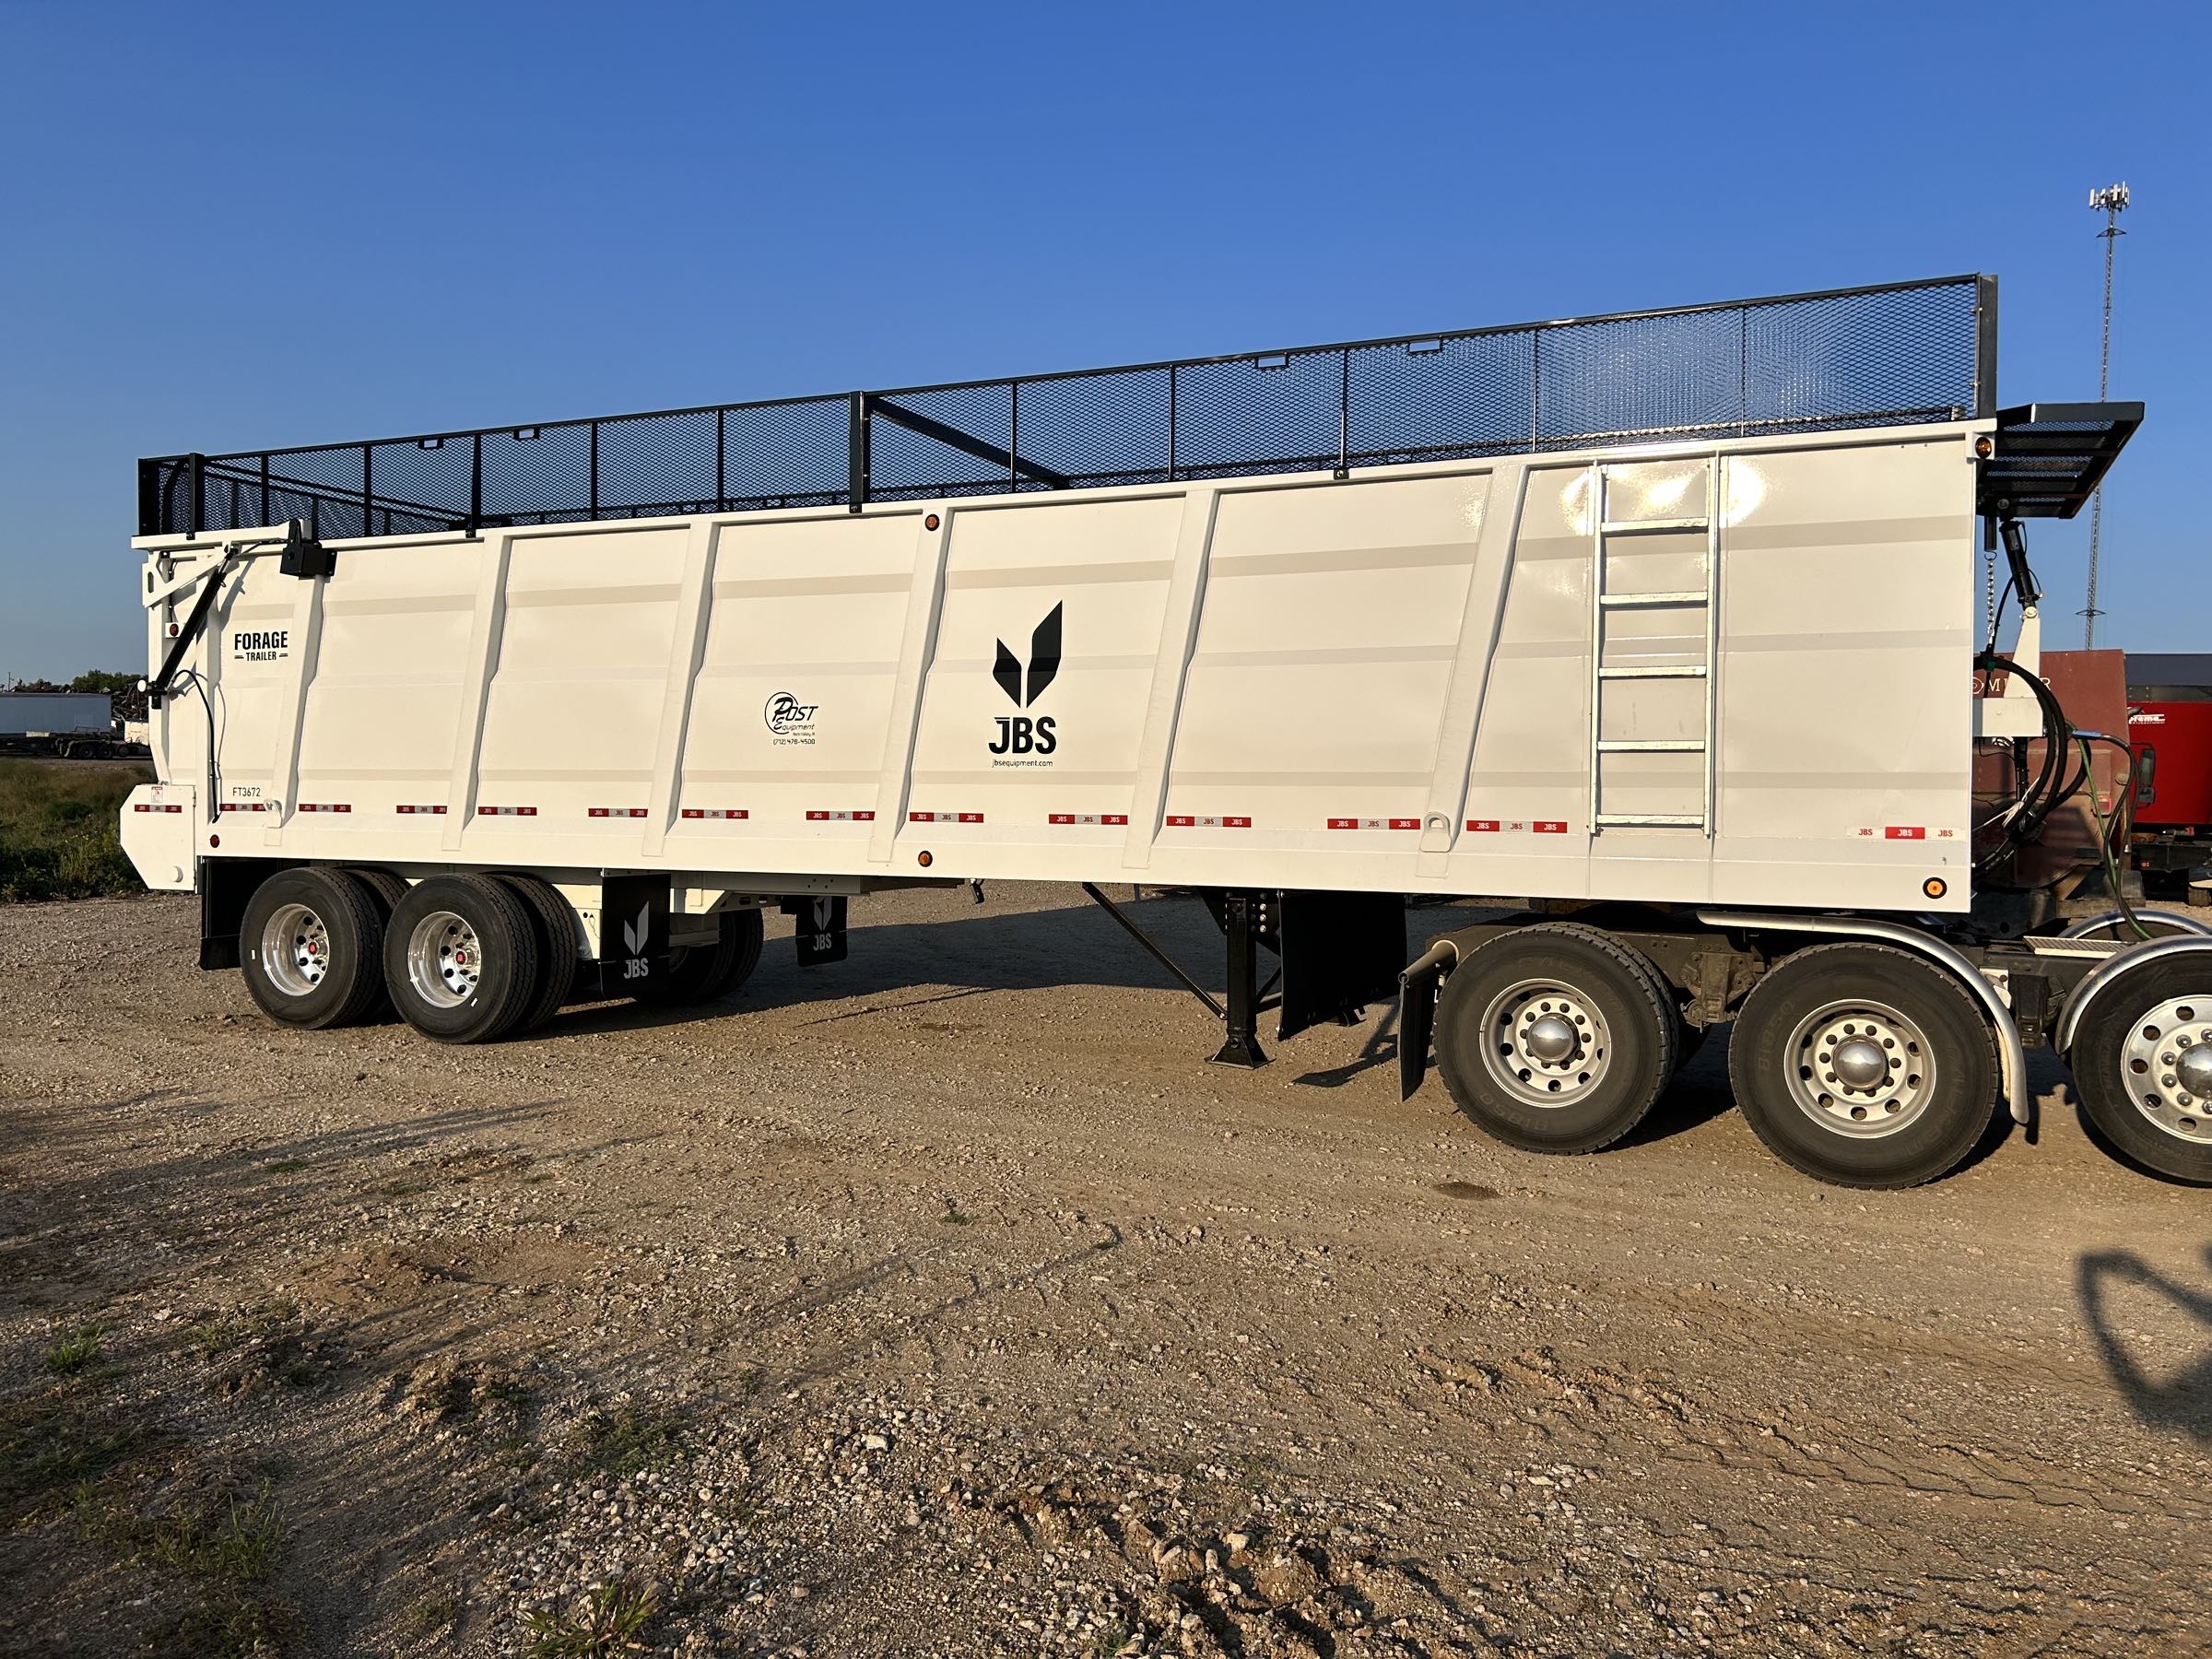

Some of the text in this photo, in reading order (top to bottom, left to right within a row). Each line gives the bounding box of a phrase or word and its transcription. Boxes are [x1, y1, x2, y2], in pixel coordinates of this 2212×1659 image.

[234, 631, 288, 650] FORAGE
[246, 652, 276, 661] TRAILER
[773, 717, 815, 731] Equipment
[989, 716, 1056, 754] JBS
[992, 759, 1053, 768] jbsequipment.com
[232, 787, 261, 797] FT3672
[813, 933, 832, 951] JBS
[623, 958, 649, 980] JBS
